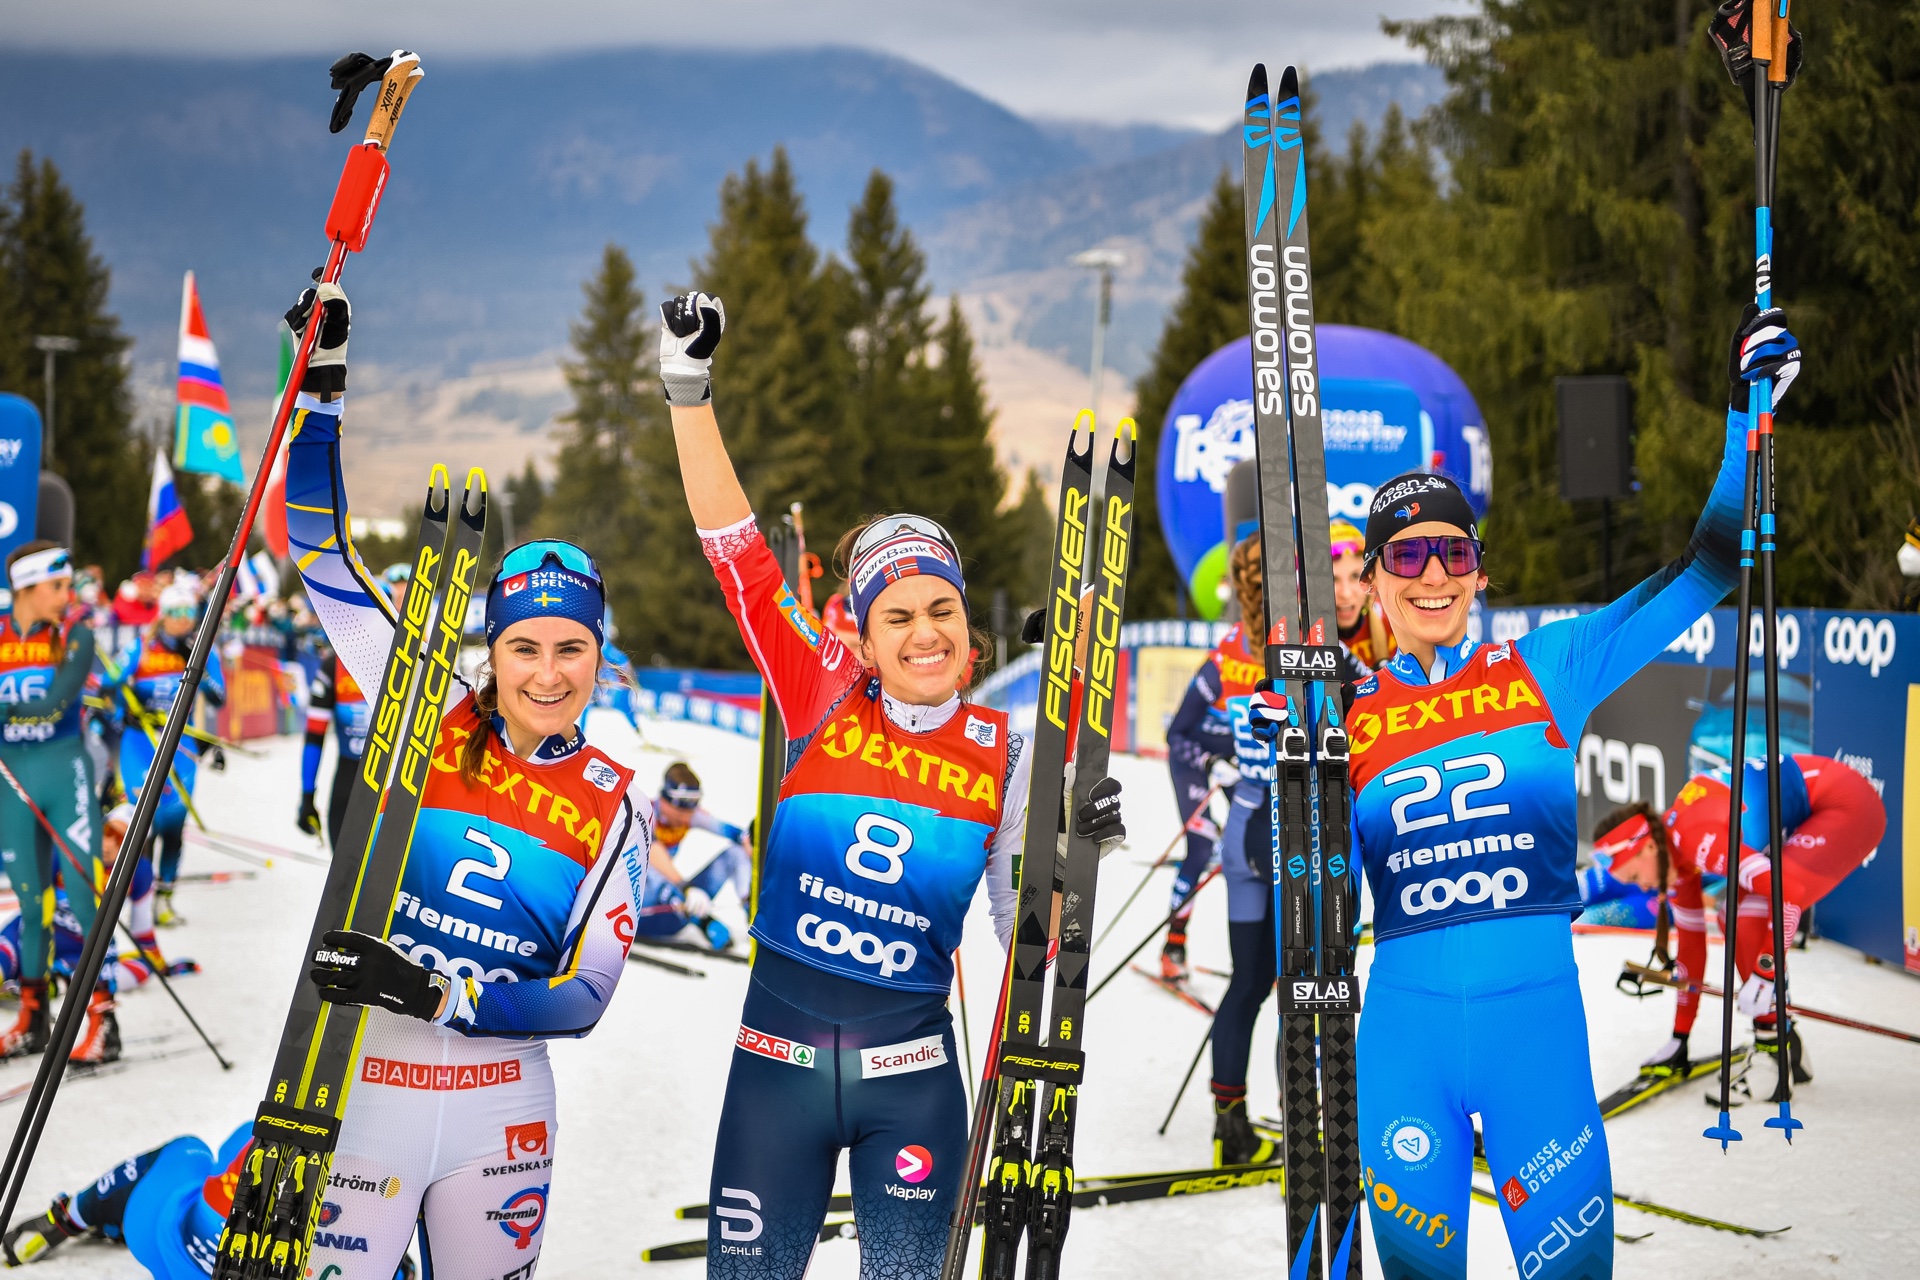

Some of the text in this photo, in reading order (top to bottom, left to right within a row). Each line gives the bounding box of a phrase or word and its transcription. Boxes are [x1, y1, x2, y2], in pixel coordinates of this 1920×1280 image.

[531, 571, 589, 591] SVENSKA
[531, 579, 566, 589] SPEL
[857, 545, 929, 588] SpareBank
[1045, 487, 1088, 731] FISCHER
[1087, 495, 1131, 739] FISCHER
[1823, 616, 1896, 678] coop
[363, 545, 441, 793] FISCHER
[400, 548, 478, 797] FISCHER
[1281, 669, 1337, 677] SELECT
[1386, 678, 1541, 736] EXTRA
[860, 733, 998, 811] EXTRA
[1575, 733, 1666, 813] ron
[472, 750, 602, 860] EXTRA
[1383, 752, 1511, 836] 22
[445, 825, 512, 910] 2
[844, 812, 914, 886] 8
[1386, 831, 1535, 874] fiemme
[798, 872, 931, 933] fiemme
[1400, 866, 1529, 916] coop
[394, 891, 539, 958] fiemme
[796, 913, 918, 978] coop
[736, 1024, 789, 1059] SPAR
[1018, 1014, 1031, 1035] 3D
[1060, 1020, 1072, 1041] 3D
[366, 1061, 519, 1088] BAUHAUS
[871, 1044, 940, 1071] Scandic
[1002, 1055, 1080, 1072] FISCHER
[274, 1082, 288, 1104] 3D
[315, 1086, 329, 1109] 3D
[257, 1115, 329, 1137] FISCHER
[482, 1157, 554, 1178] SVENSKA SPE
[1519, 1138, 1562, 1180] CAISSE
[326, 1172, 377, 1192] ström
[885, 1183, 937, 1202] viaplay
[1167, 1168, 1283, 1197] FISCHER
[485, 1207, 538, 1222] Thermia
[1365, 1166, 1457, 1249] somfy
[313, 1232, 369, 1253] ANIA
